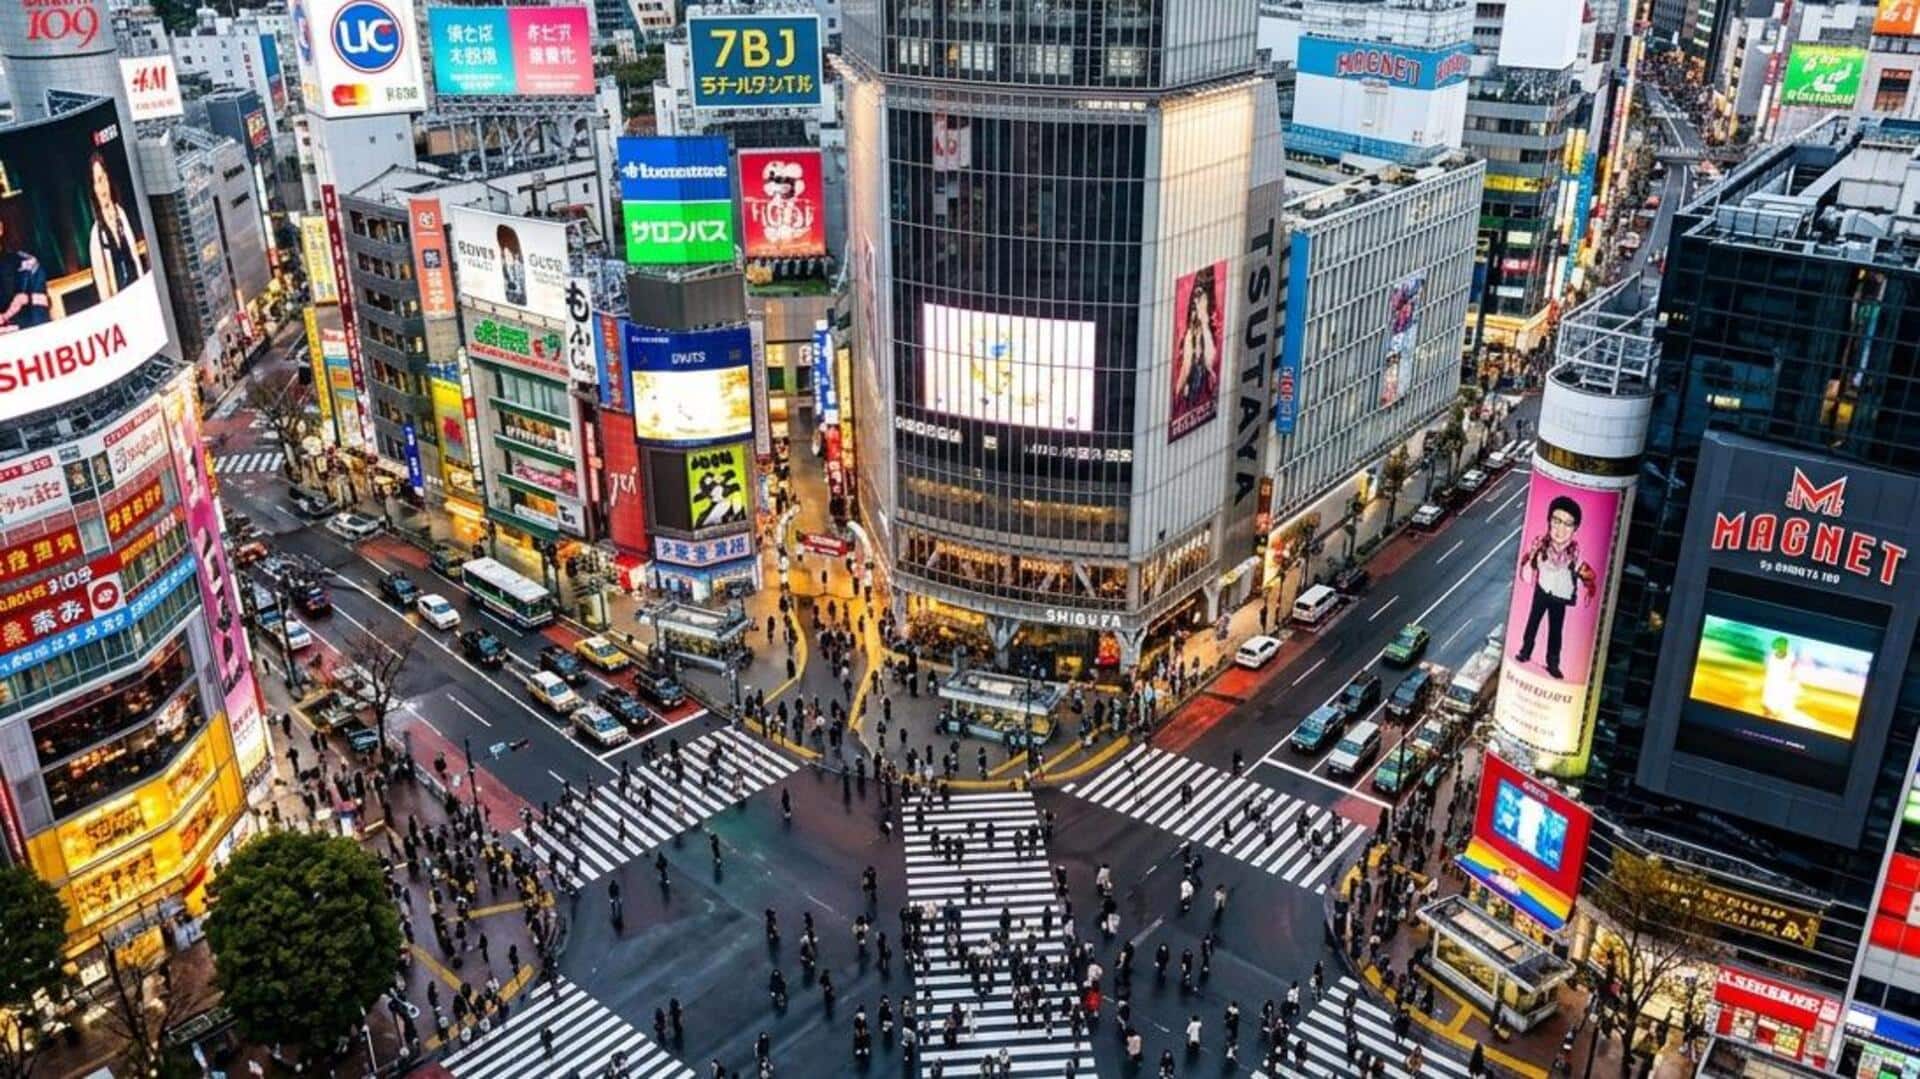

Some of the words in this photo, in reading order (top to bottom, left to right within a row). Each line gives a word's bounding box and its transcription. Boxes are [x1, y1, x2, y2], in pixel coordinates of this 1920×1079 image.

[26, 6, 99, 48] 109
[340, 18, 395, 53] UC
[0, 323, 127, 392] SHIBUYA
[1234, 218, 1274, 506] TSUTAYA
[1712, 511, 1907, 585] MAGNET
